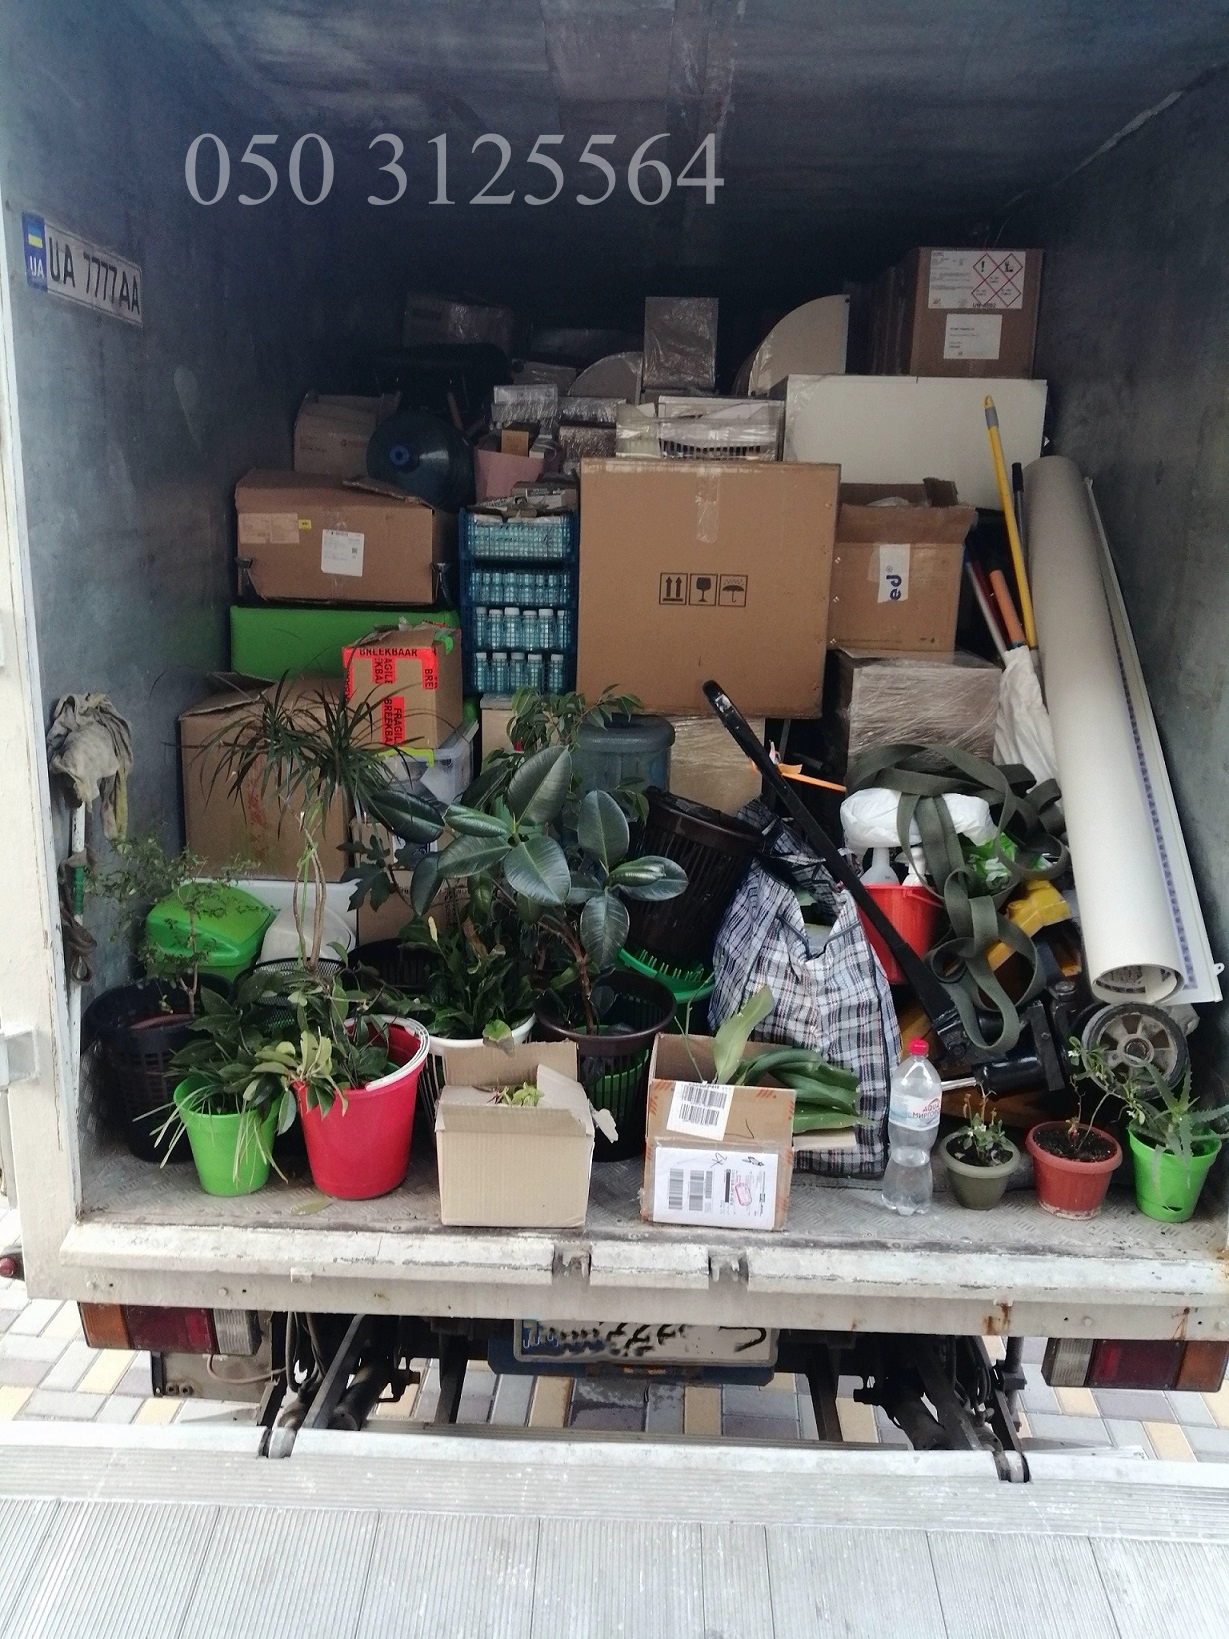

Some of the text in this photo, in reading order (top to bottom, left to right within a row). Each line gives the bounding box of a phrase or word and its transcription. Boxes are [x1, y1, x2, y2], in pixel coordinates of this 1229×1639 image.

[29, 255, 45, 279] UA
[49, 236, 76, 288] UA
[393, 707, 402, 745] FRAGIL
